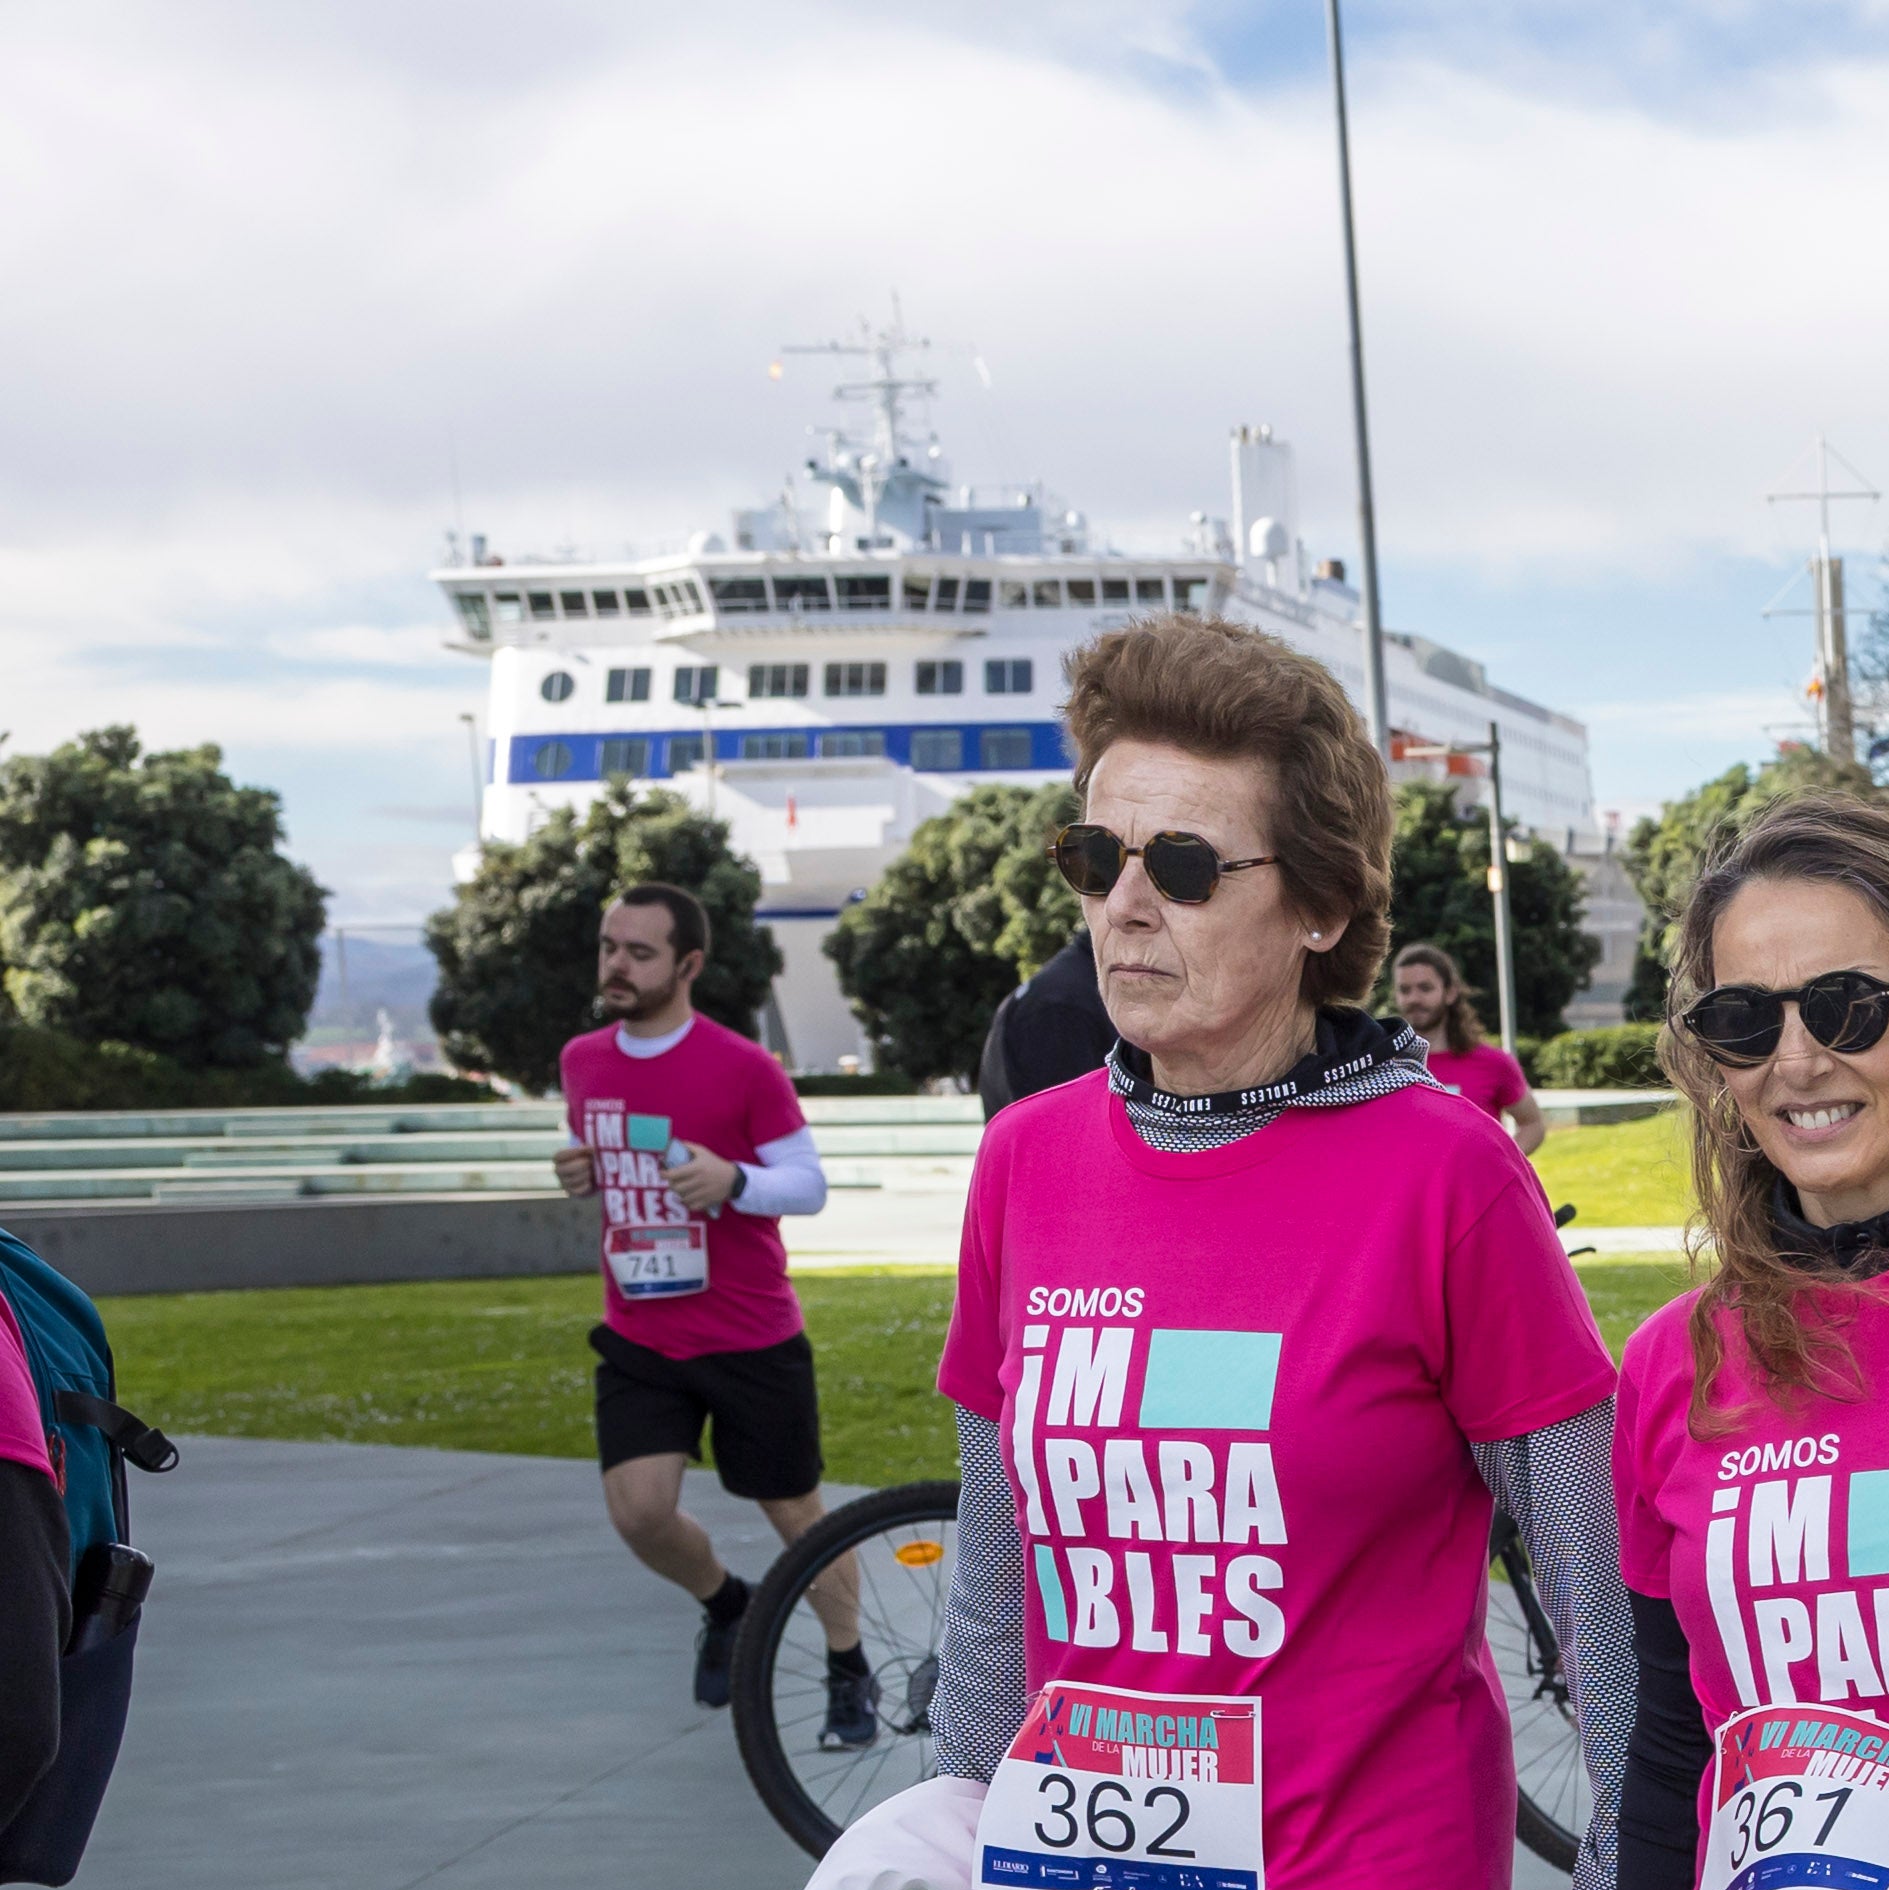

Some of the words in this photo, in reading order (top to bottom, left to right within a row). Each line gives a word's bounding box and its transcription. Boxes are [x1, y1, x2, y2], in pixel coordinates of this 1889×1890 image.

[1241, 1081, 1297, 1105] ENDLESS
[602, 1150, 669, 1188] PAR
[627, 1254, 676, 1278] 741
[1026, 1286, 1145, 1318] SOMOS
[1717, 1433, 1840, 1481] SOMOS
[1045, 1438, 1289, 1546] PARA
[1065, 1549, 1286, 1658] BLES
[1068, 1703, 1093, 1737] VI
[1095, 1707, 1219, 1749] MARCHA
[1759, 1721, 1791, 1751] VI
[1092, 1741, 1105, 1753] DE
[1106, 1742, 1120, 1755] LA
[1121, 1745, 1219, 1783] MUJER
[1034, 1773, 1196, 1859] 362
